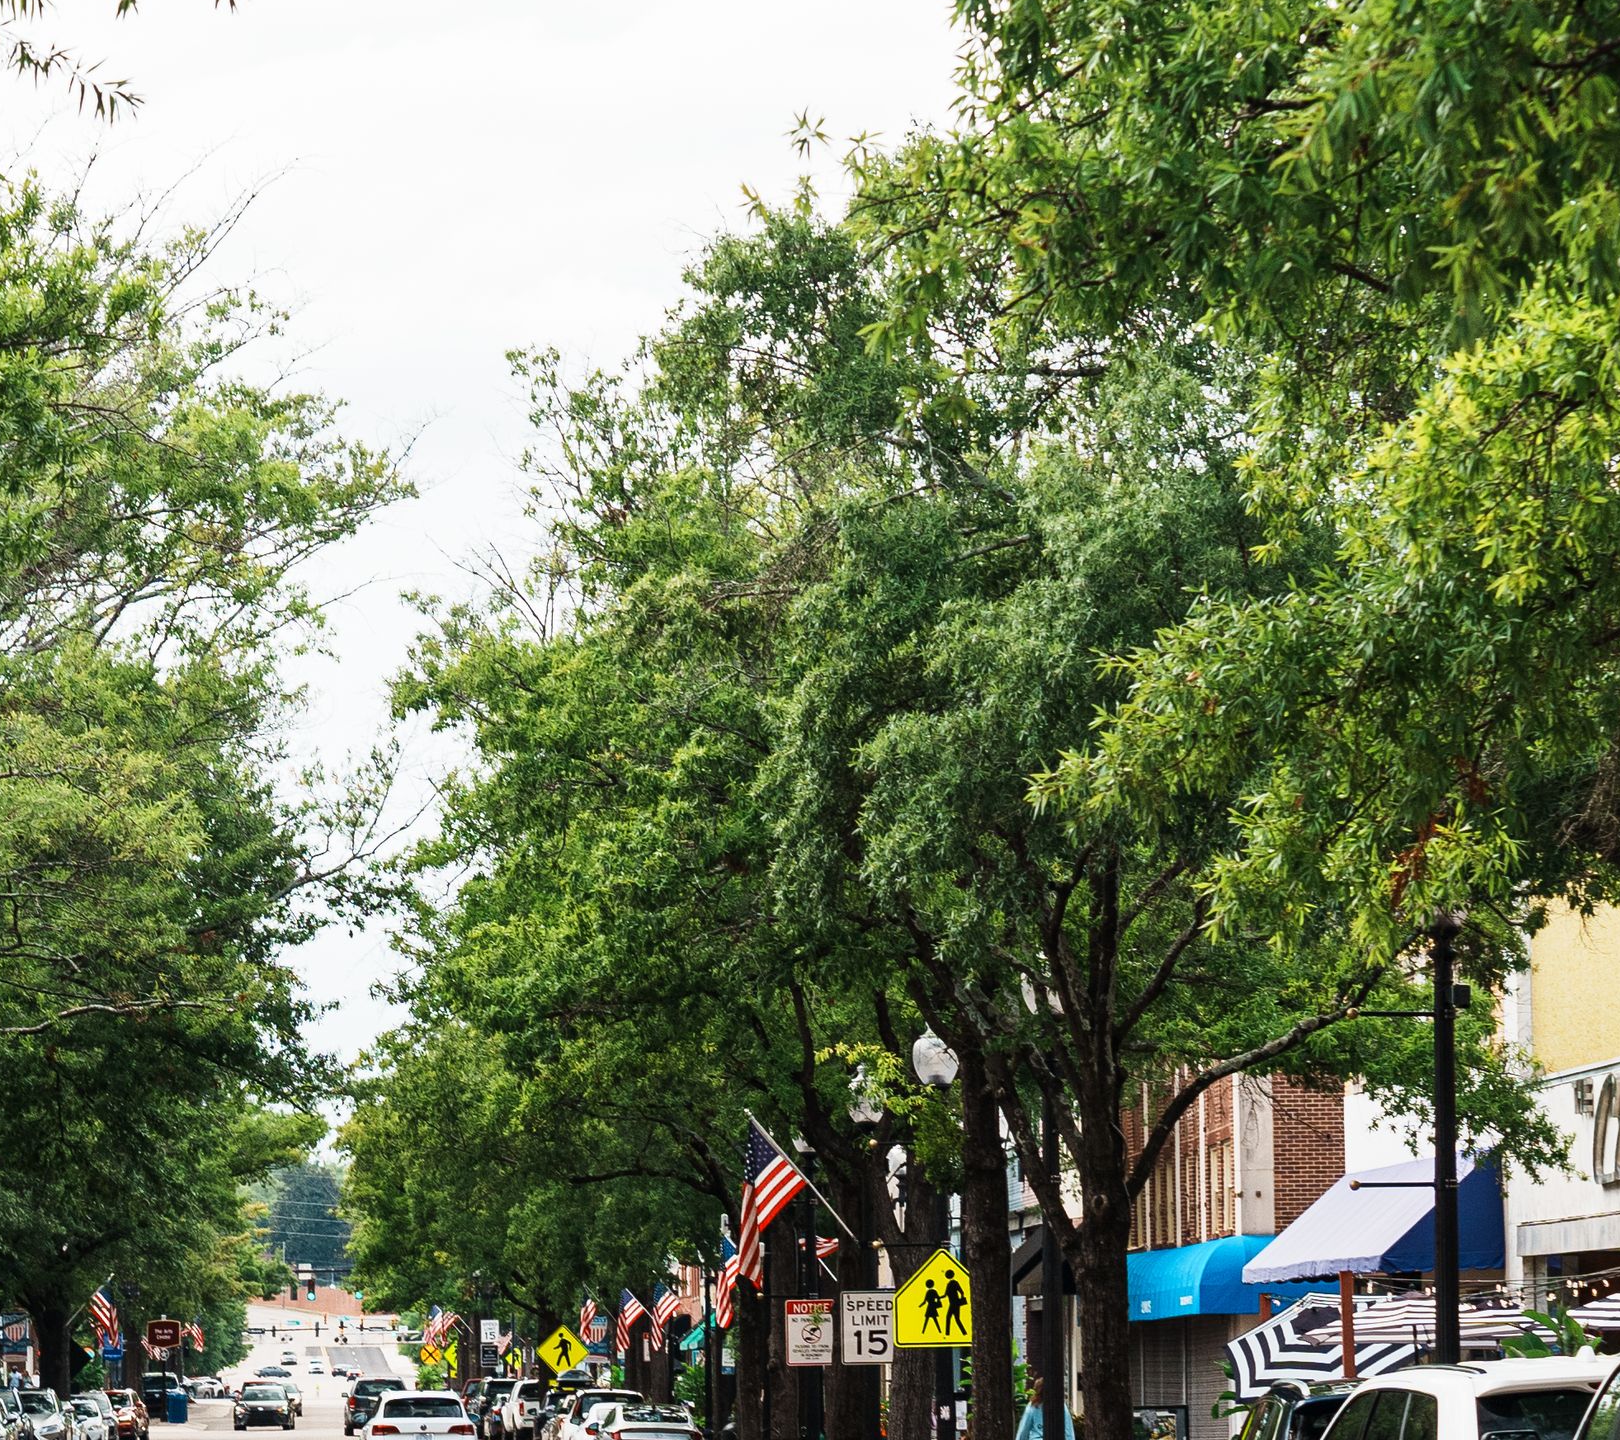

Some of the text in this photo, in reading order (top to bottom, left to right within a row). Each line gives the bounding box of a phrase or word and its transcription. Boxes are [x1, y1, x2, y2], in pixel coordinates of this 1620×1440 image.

[793, 1303, 830, 1314] NOTICE
[847, 1301, 893, 1312] SPEED
[852, 1315, 889, 1326] LIMIT
[484, 1331, 496, 1340] 15
[853, 1329, 888, 1356] 15
